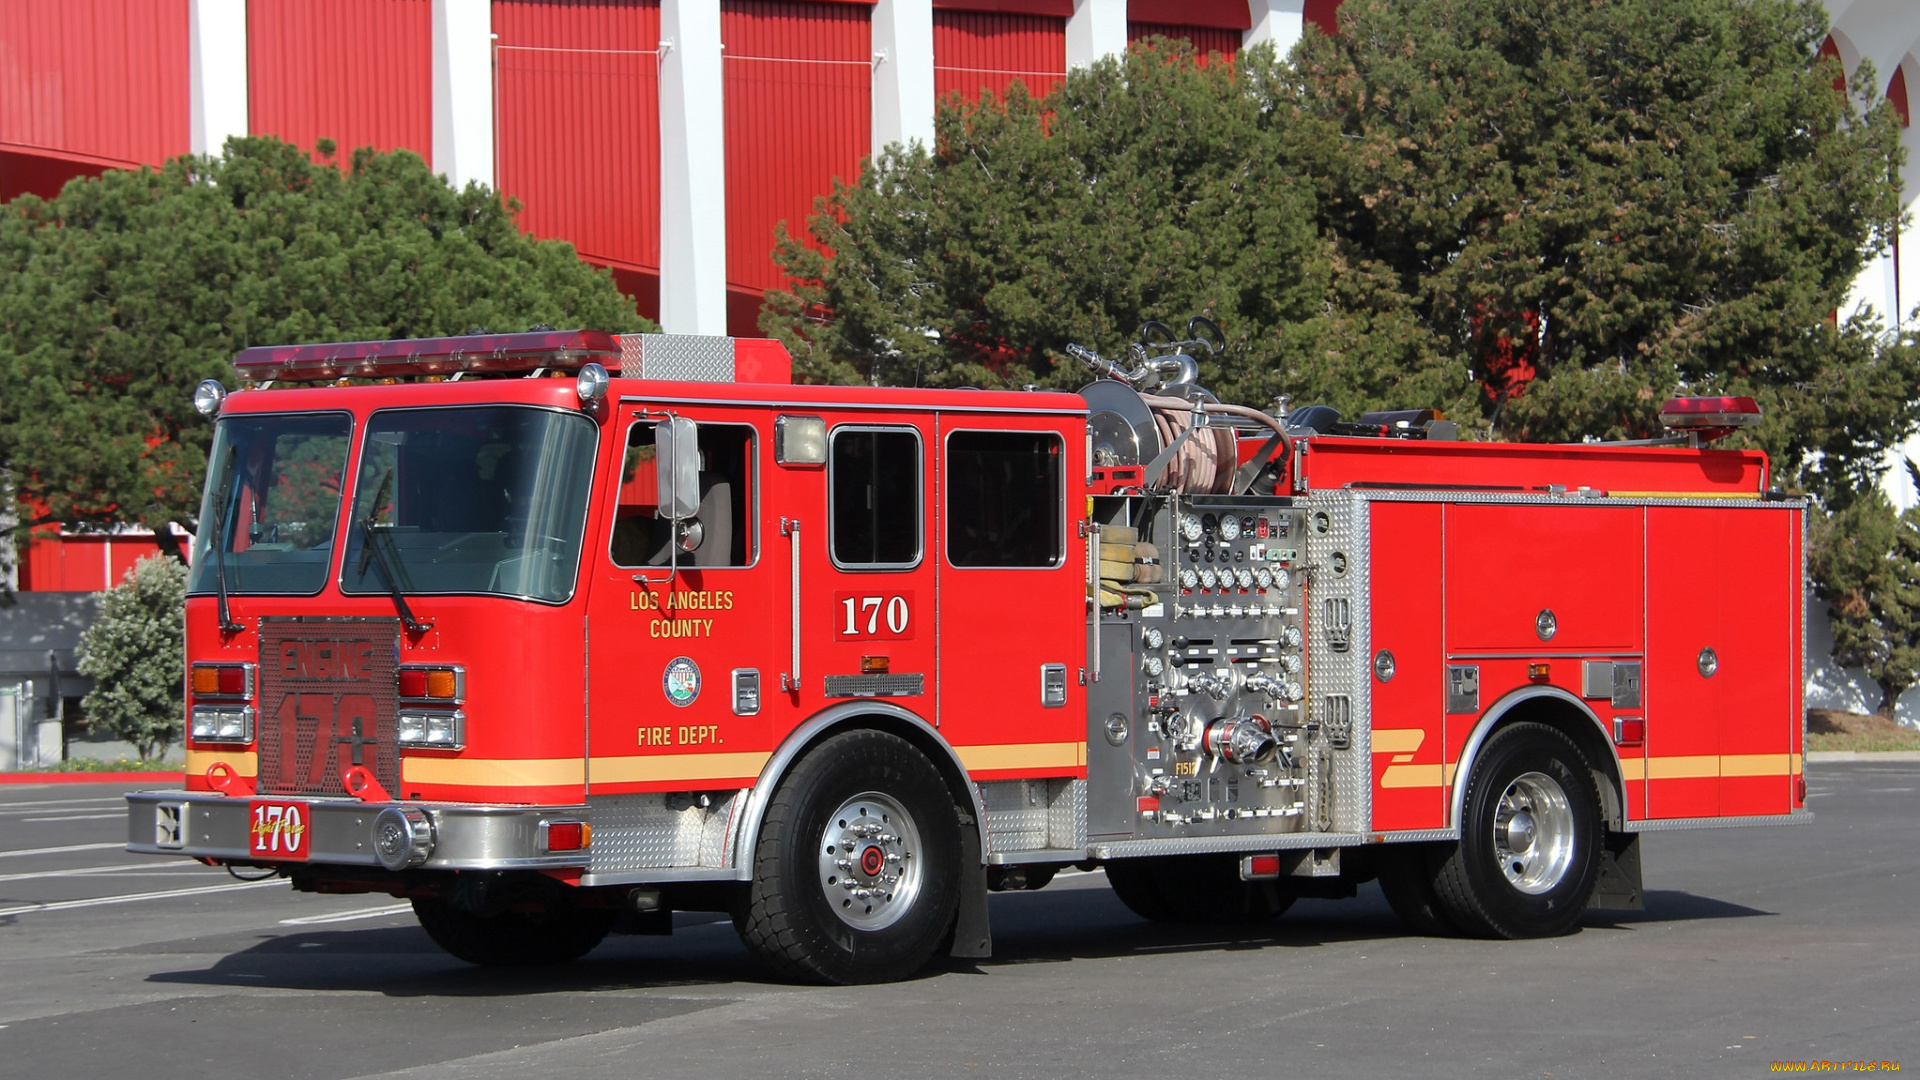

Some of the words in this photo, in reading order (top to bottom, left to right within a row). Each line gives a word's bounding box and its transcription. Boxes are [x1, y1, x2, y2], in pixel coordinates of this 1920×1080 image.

[630, 591, 659, 611] LOS
[666, 590, 734, 610] ANGELES
[841, 595, 910, 636] 170
[649, 618, 714, 639] COUNTY
[279, 639, 373, 681] ENGINE
[273, 692, 379, 787] 170
[637, 726, 672, 746] FIRE
[678, 725, 724, 744] DEPT.
[254, 805, 301, 852] 170
